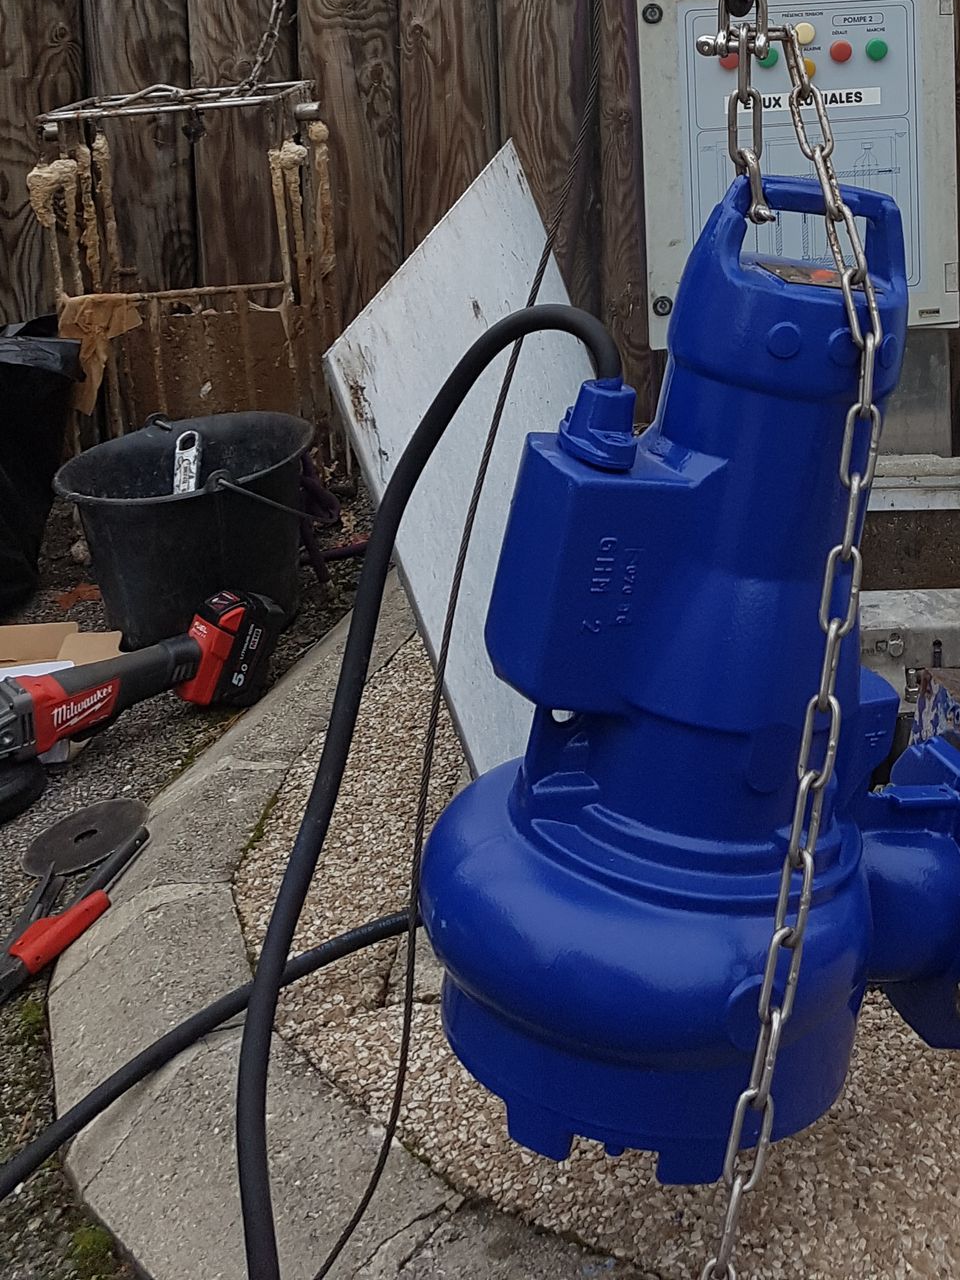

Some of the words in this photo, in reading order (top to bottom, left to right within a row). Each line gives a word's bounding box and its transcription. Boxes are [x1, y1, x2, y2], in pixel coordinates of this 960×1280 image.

[843, 16, 867, 24] POMPE
[743, 96, 782, 110] EUX
[51, 684, 113, 728] Milwaukee
